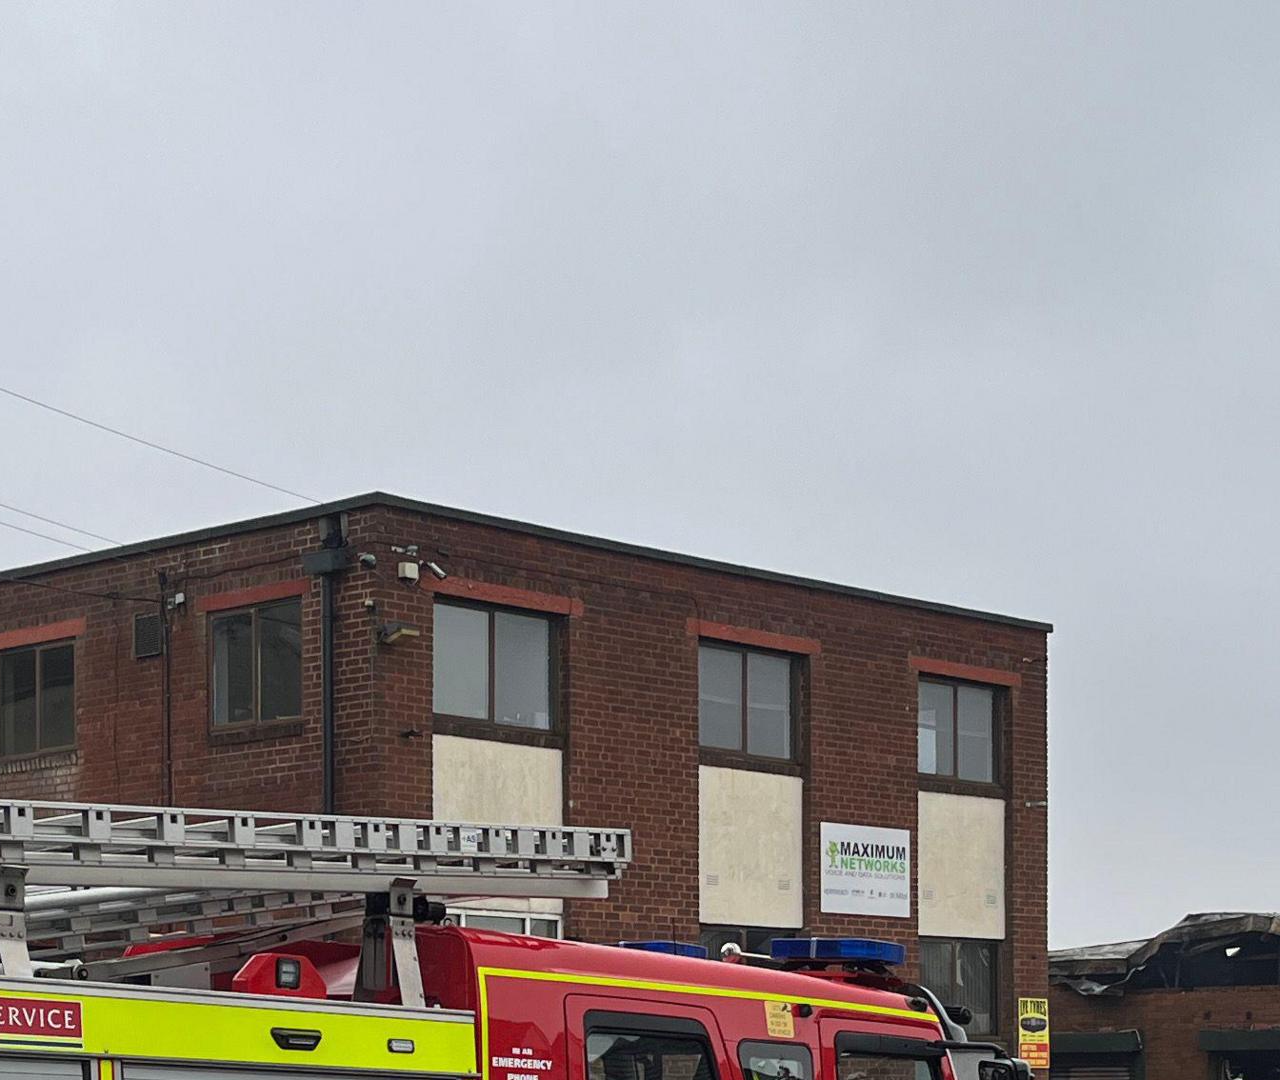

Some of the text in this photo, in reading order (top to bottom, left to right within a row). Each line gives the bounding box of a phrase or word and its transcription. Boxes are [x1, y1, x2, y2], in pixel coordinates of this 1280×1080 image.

[840, 841, 906, 860] MAXIMUM
[840, 857, 906, 873] NETWORKS
[511, 1047, 533, 1056] IN AN
[492, 1056, 552, 1071] EMERGENCY
